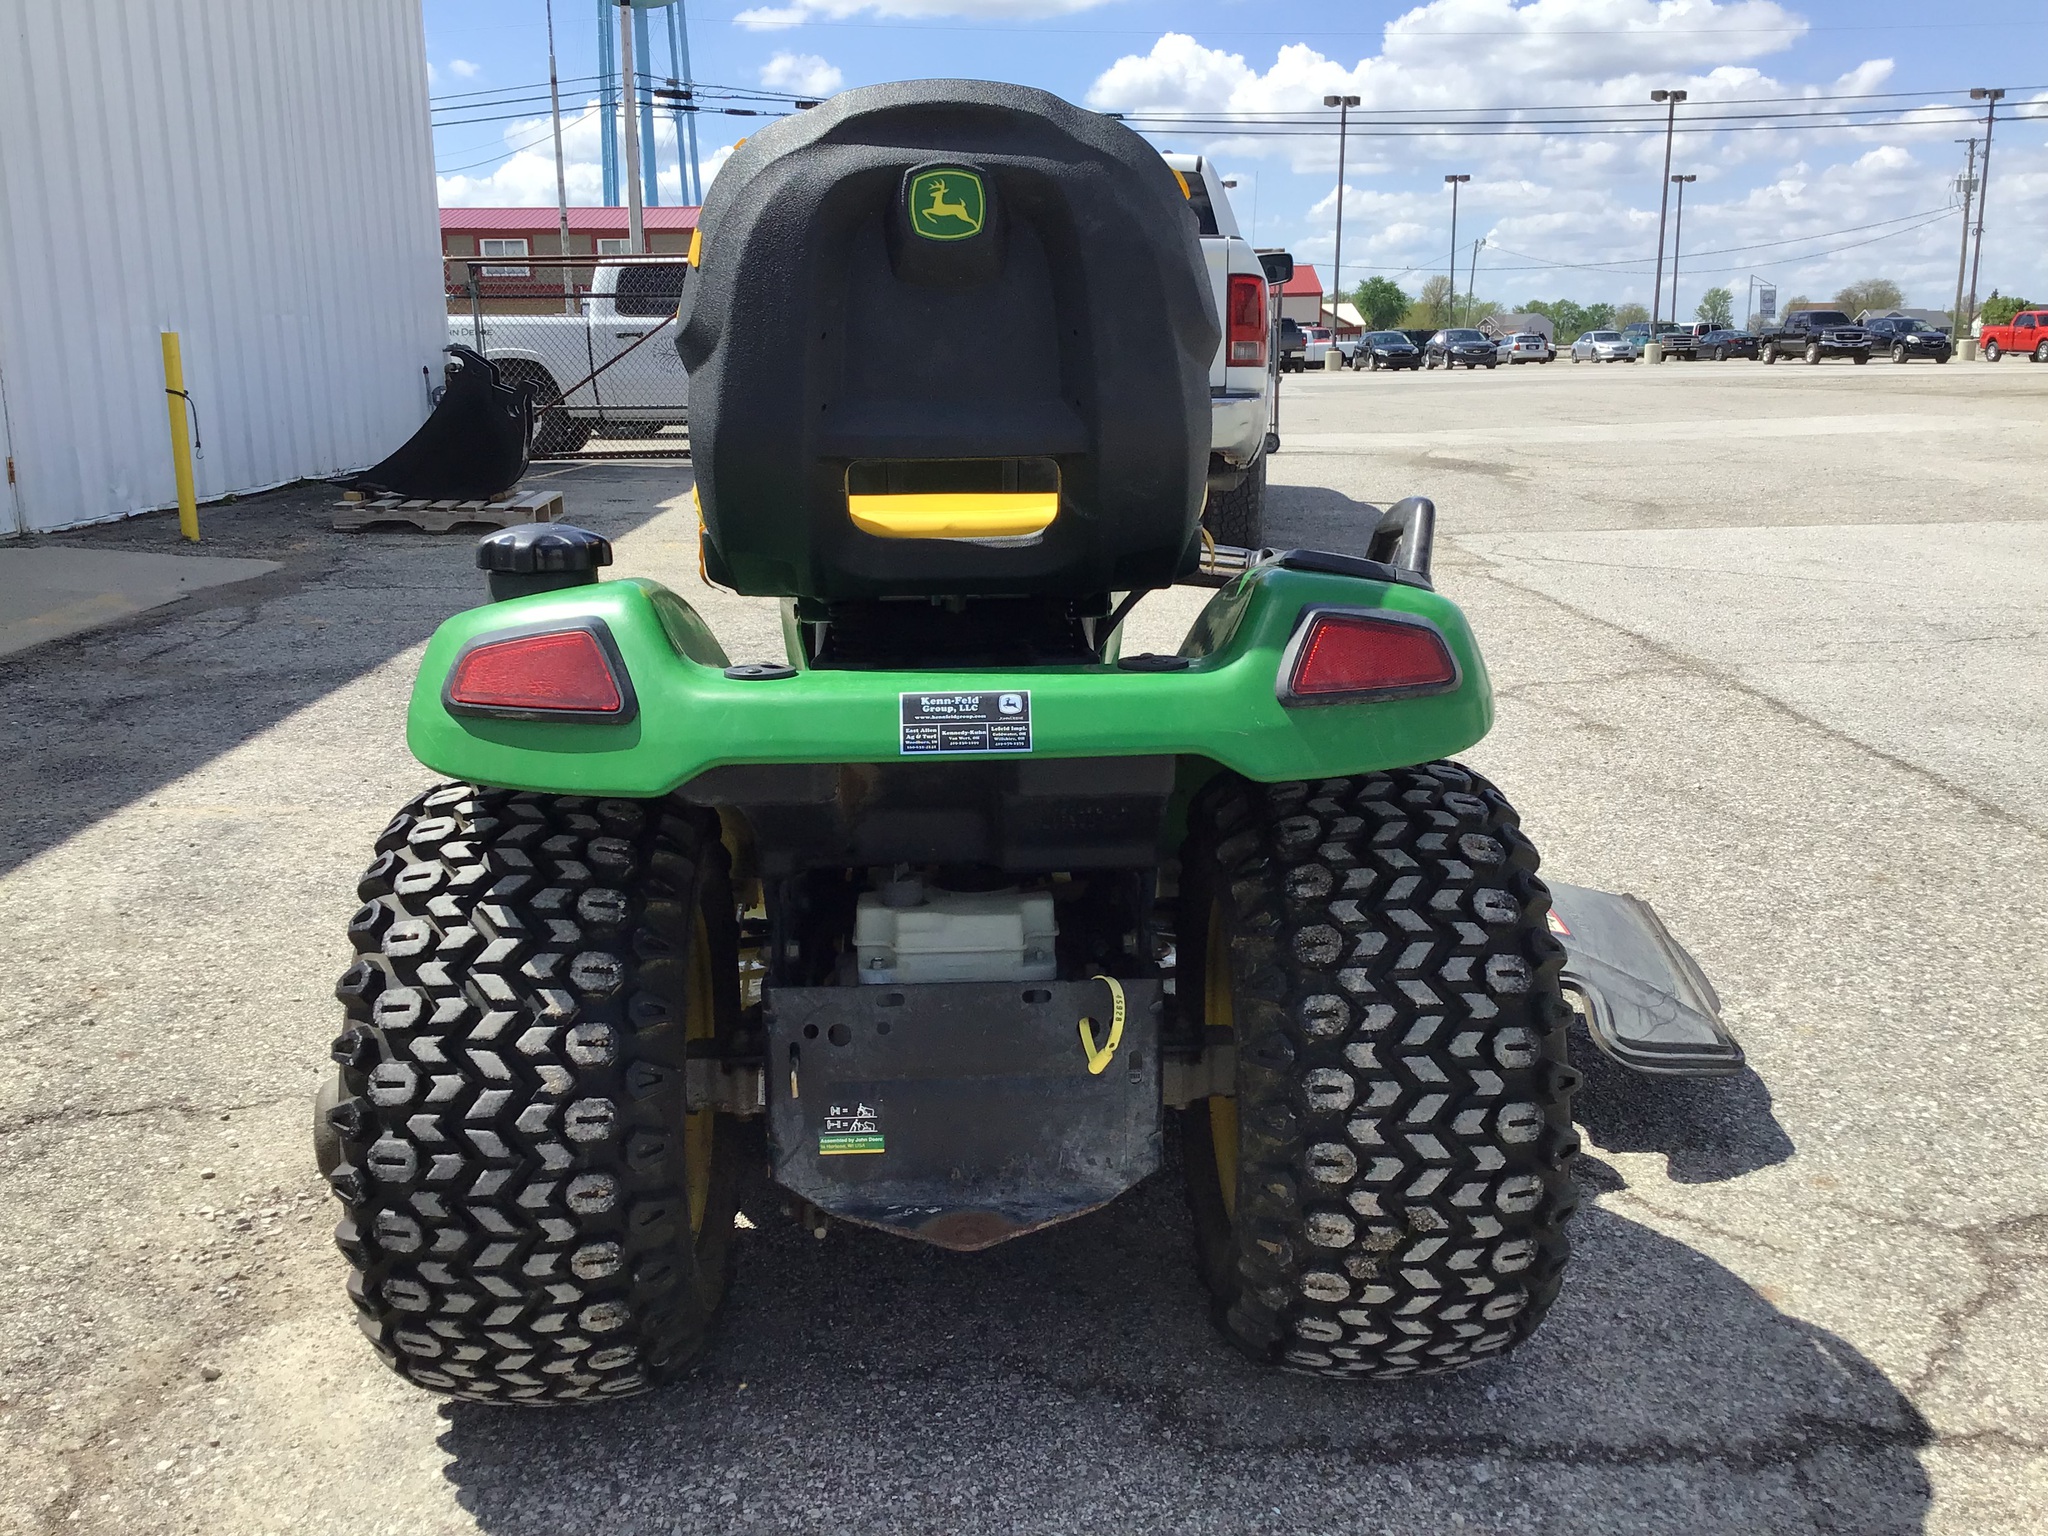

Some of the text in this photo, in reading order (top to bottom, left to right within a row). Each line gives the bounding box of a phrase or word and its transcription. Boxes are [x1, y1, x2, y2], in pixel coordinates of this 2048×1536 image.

[920, 696, 980, 706] Kenn-Feld
[922, 704, 979, 713] Group, LLC
